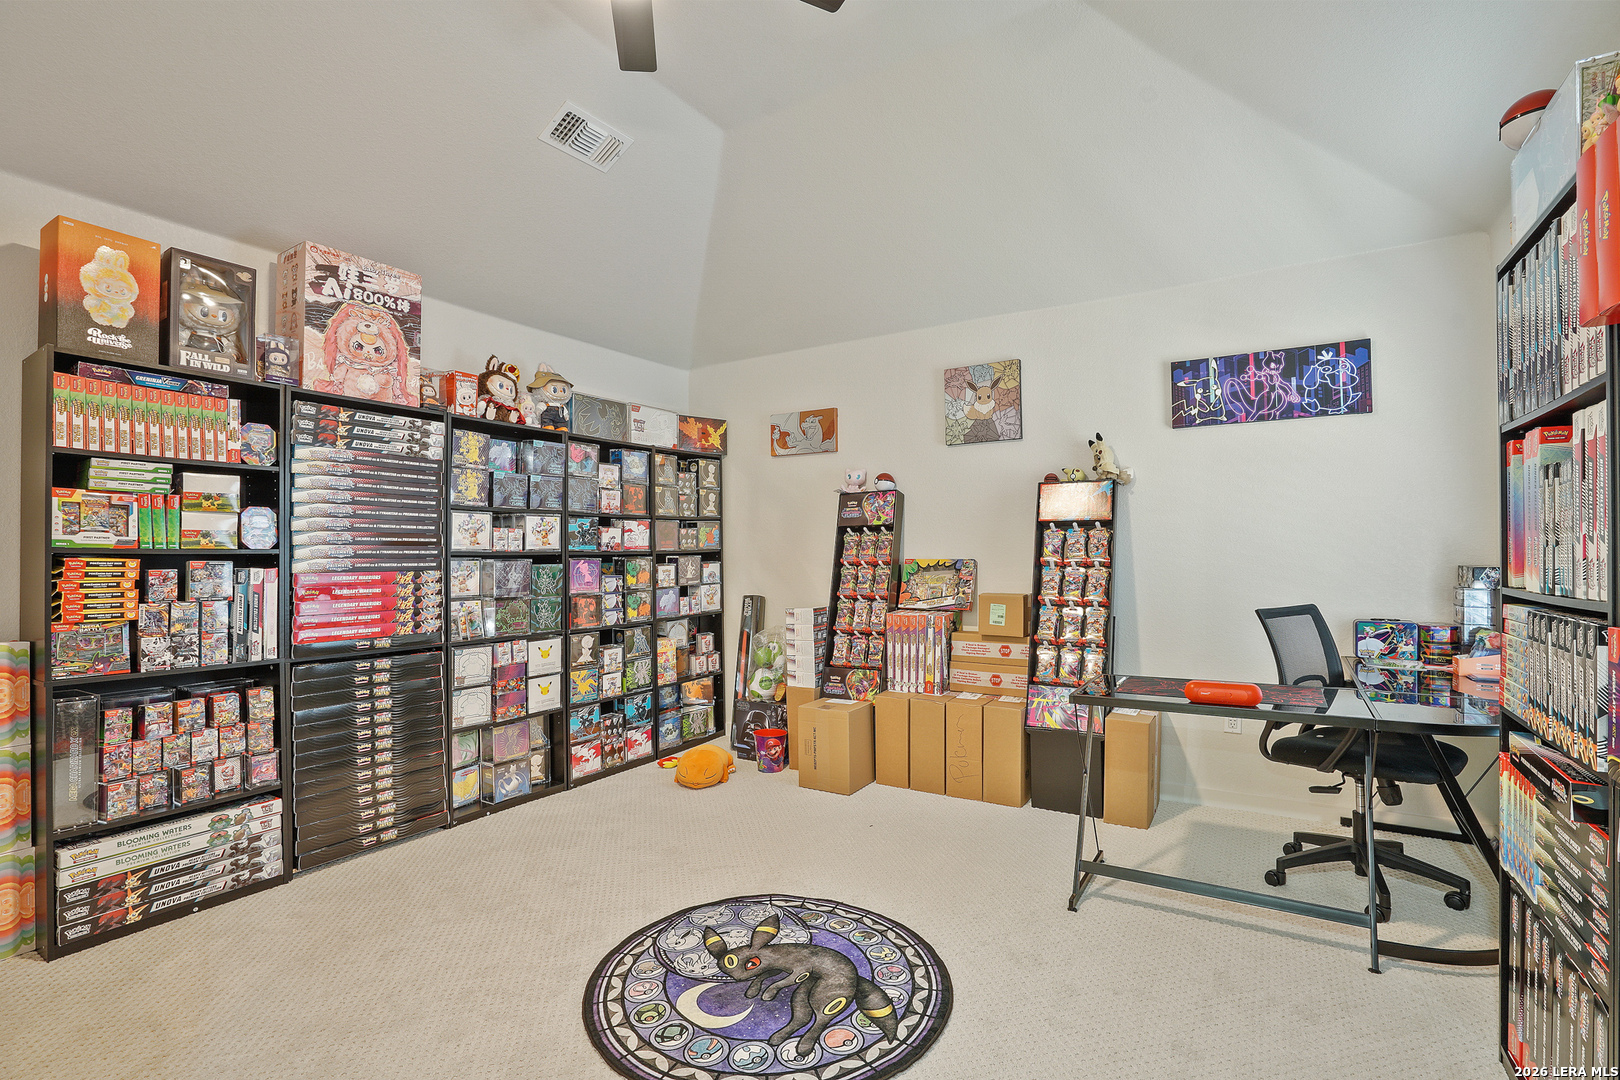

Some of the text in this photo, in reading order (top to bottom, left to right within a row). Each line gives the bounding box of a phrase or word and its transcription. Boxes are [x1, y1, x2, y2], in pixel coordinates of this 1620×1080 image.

[1601, 189, 1611, 241] Pokémon
[1581, 208, 1591, 257] Pokémon
[180, 350, 211, 366] FALL
[189, 359, 201, 369] IN
[202, 361, 230, 373] WILD
[116, 824, 192, 848] BLOOMING WATERS
[115, 841, 191, 866] BLOOMING WATERS
[154, 862, 181, 875] UNOVA
[154, 879, 181, 892] UNOVA
[155, 896, 182, 909] UNOVA
